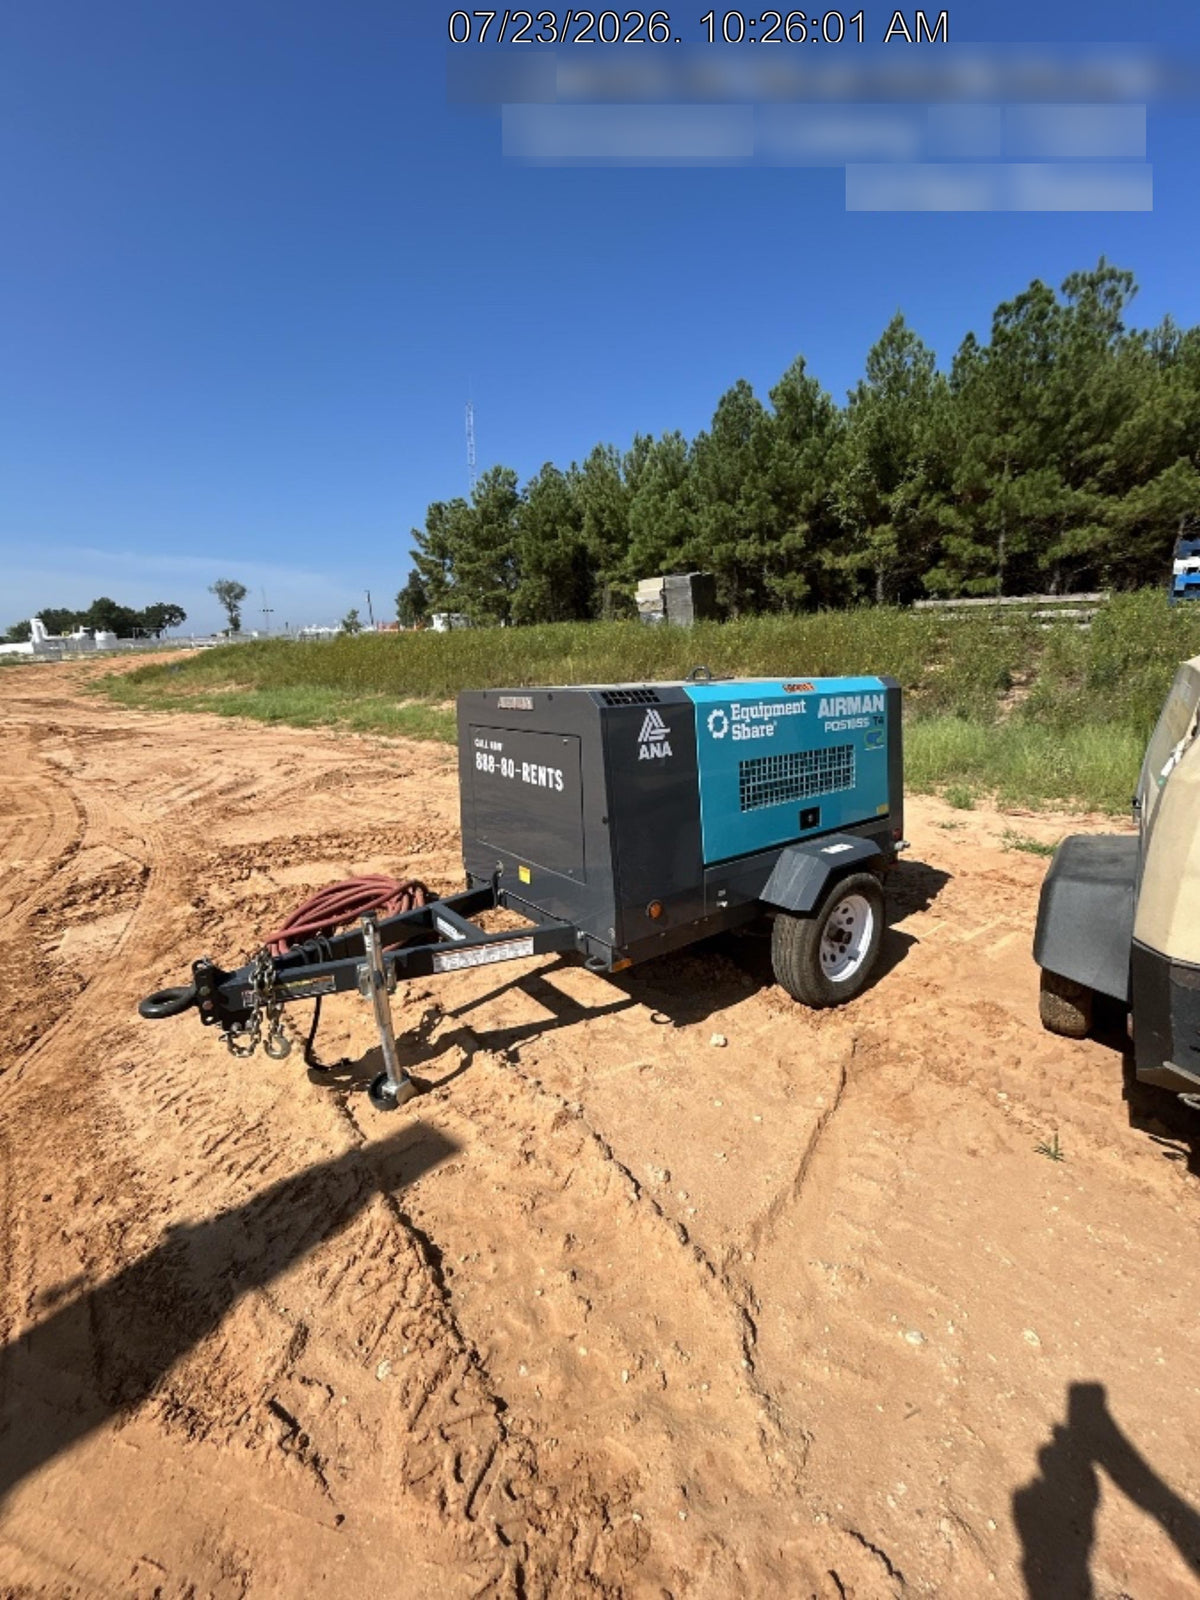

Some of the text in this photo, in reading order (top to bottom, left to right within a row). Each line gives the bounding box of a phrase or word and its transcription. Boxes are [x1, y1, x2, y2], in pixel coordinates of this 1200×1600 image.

[730, 699, 807, 722] Equipment
[818, 694, 885, 719] AIRMAN
[731, 722, 775, 741] Share
[638, 741, 673, 761] ANA
[476, 751, 564, 791] 888-80-RENTS
